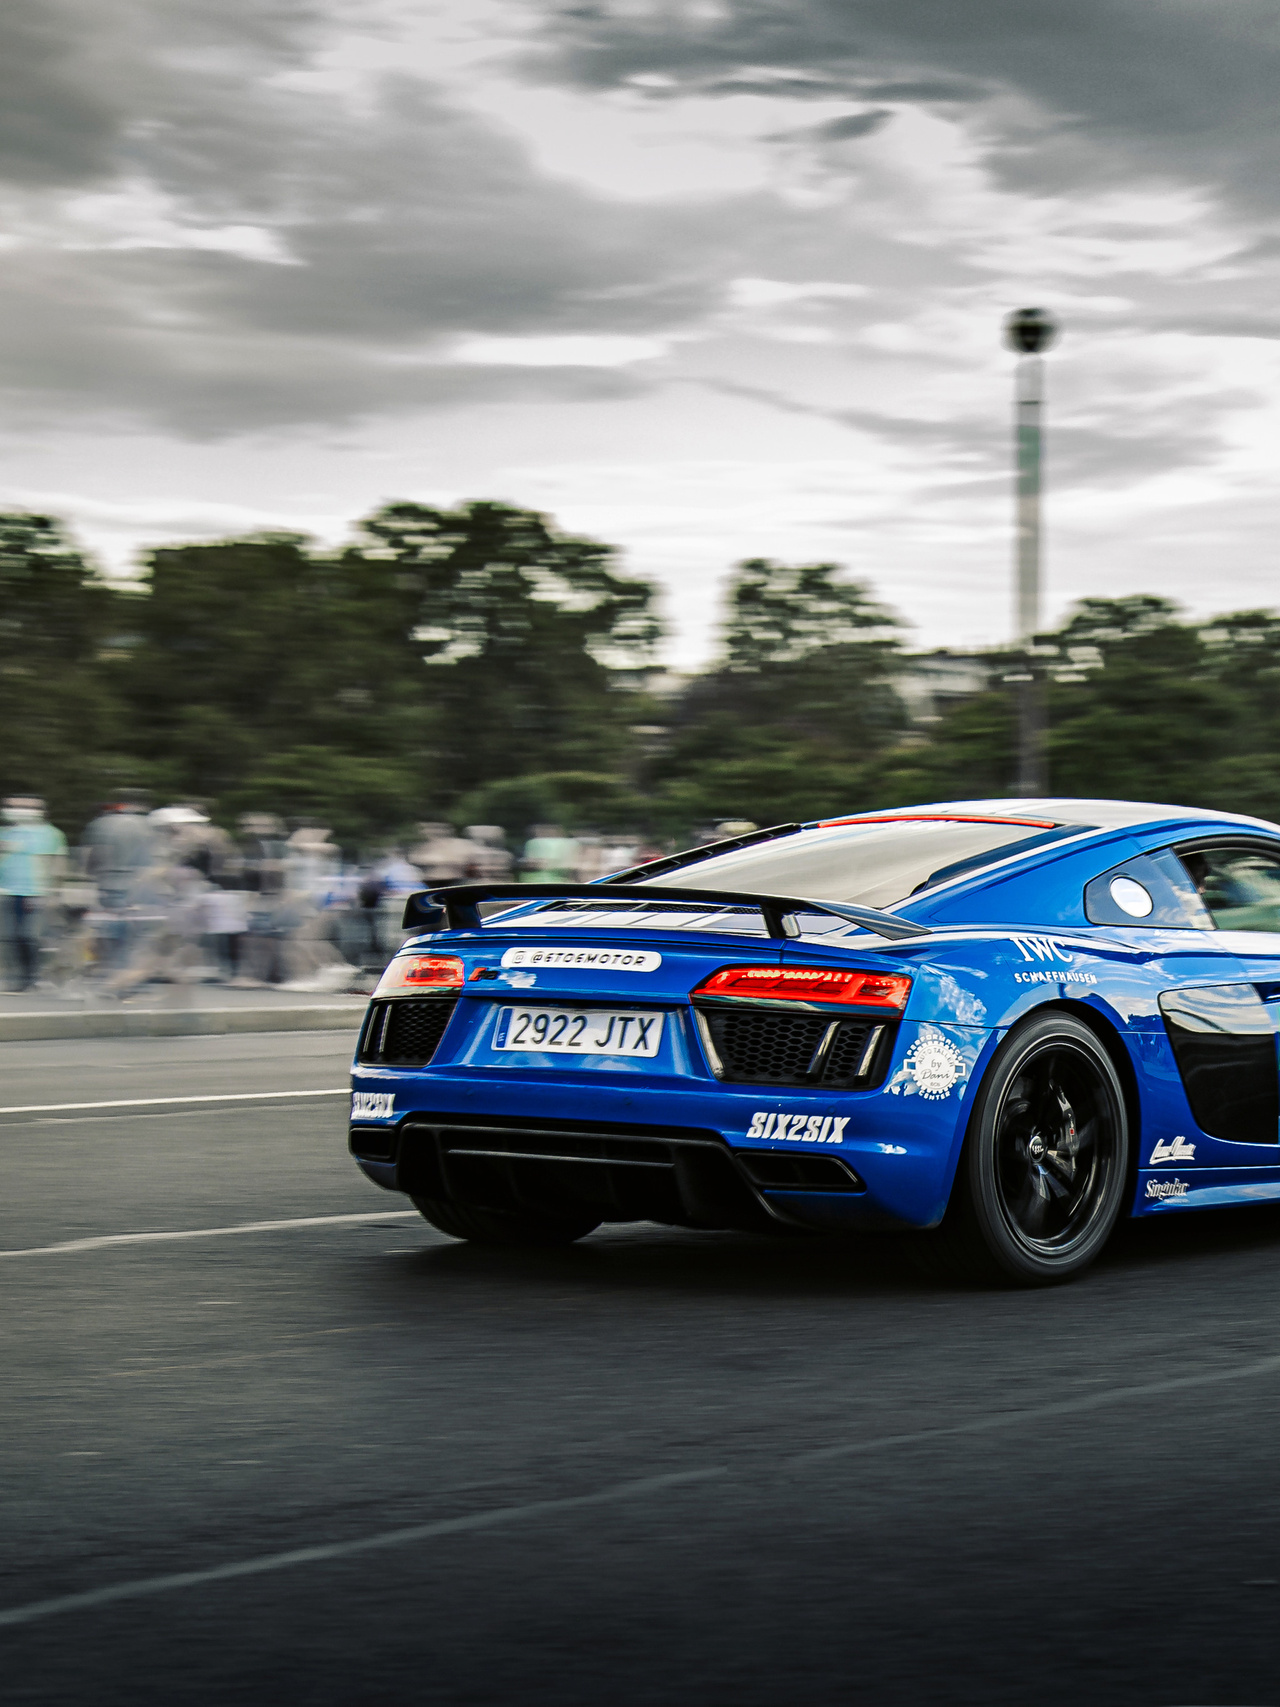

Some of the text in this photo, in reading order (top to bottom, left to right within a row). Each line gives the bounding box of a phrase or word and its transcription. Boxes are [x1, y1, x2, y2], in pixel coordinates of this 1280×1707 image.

[1009, 937, 1074, 963] IWC
[1014, 971, 1098, 984] SCHAFFHAUSEN
[511, 1013, 656, 1050] 2922 JTX
[906, 1033, 963, 1061] PERFORMANCE
[931, 1059, 943, 1071] by
[918, 1089, 951, 1101] CENTER
[745, 1112, 852, 1144] SIX2SIX
